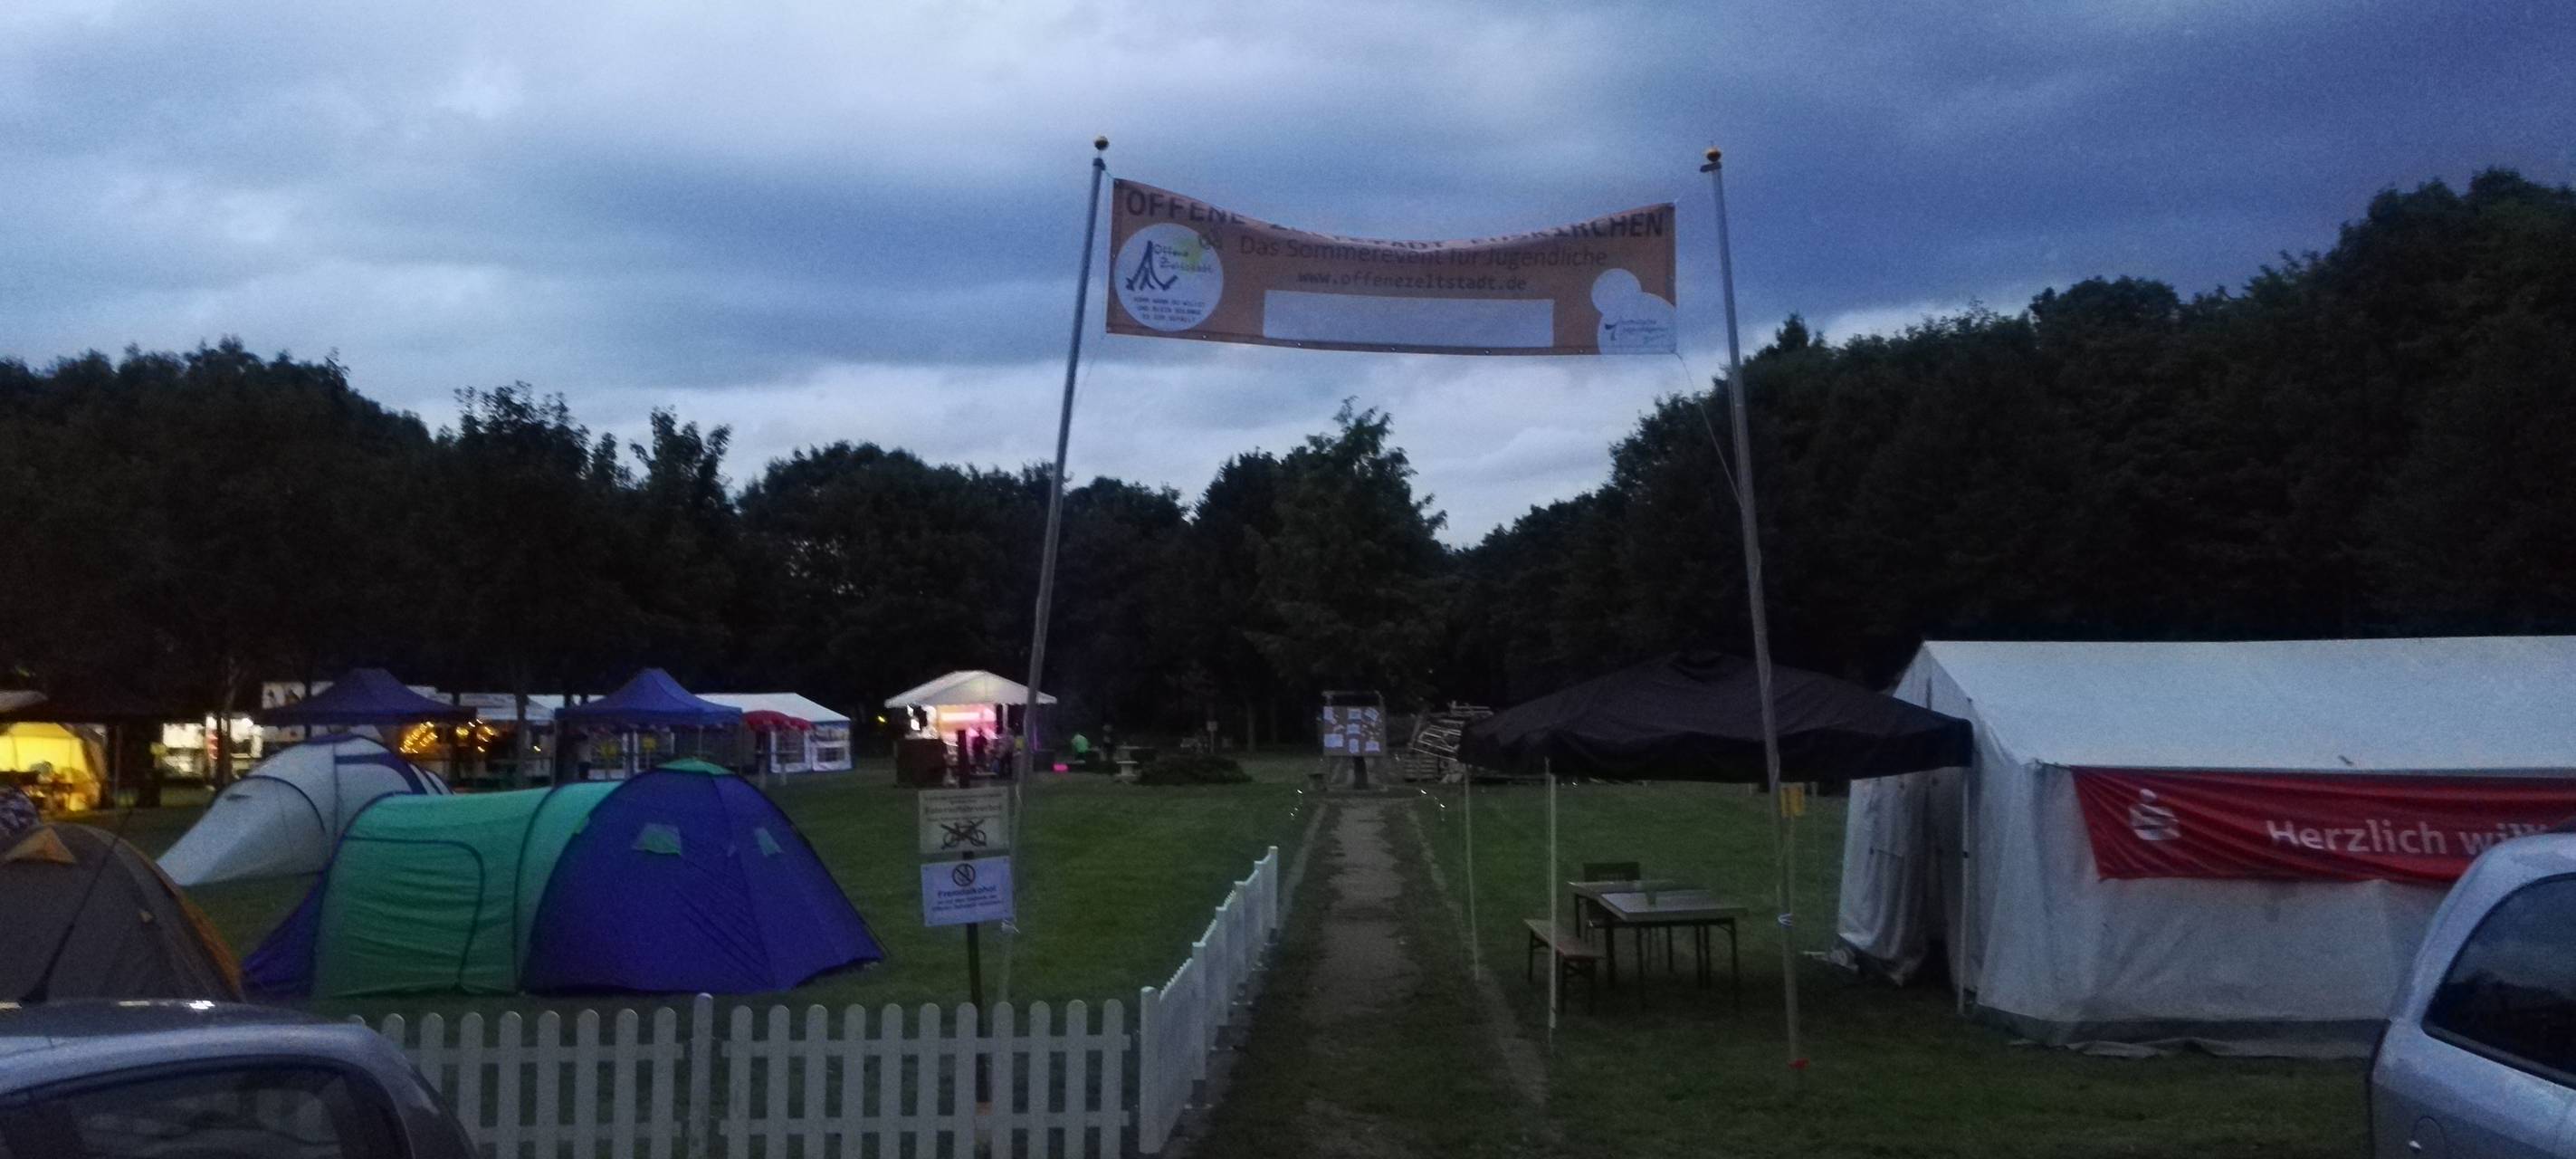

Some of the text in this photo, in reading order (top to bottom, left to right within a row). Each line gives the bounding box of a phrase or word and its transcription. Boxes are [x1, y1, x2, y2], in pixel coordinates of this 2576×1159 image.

[1126, 188, 1246, 225] OFFENE
[1240, 235, 1280, 257] Das
[1286, 239, 1443, 265] Sommerevent
[1486, 247, 1608, 270] Jugendliche
[1296, 271, 1528, 291] www.offenezeltstadt.de
[2266, 819, 2447, 856] Herzlich
